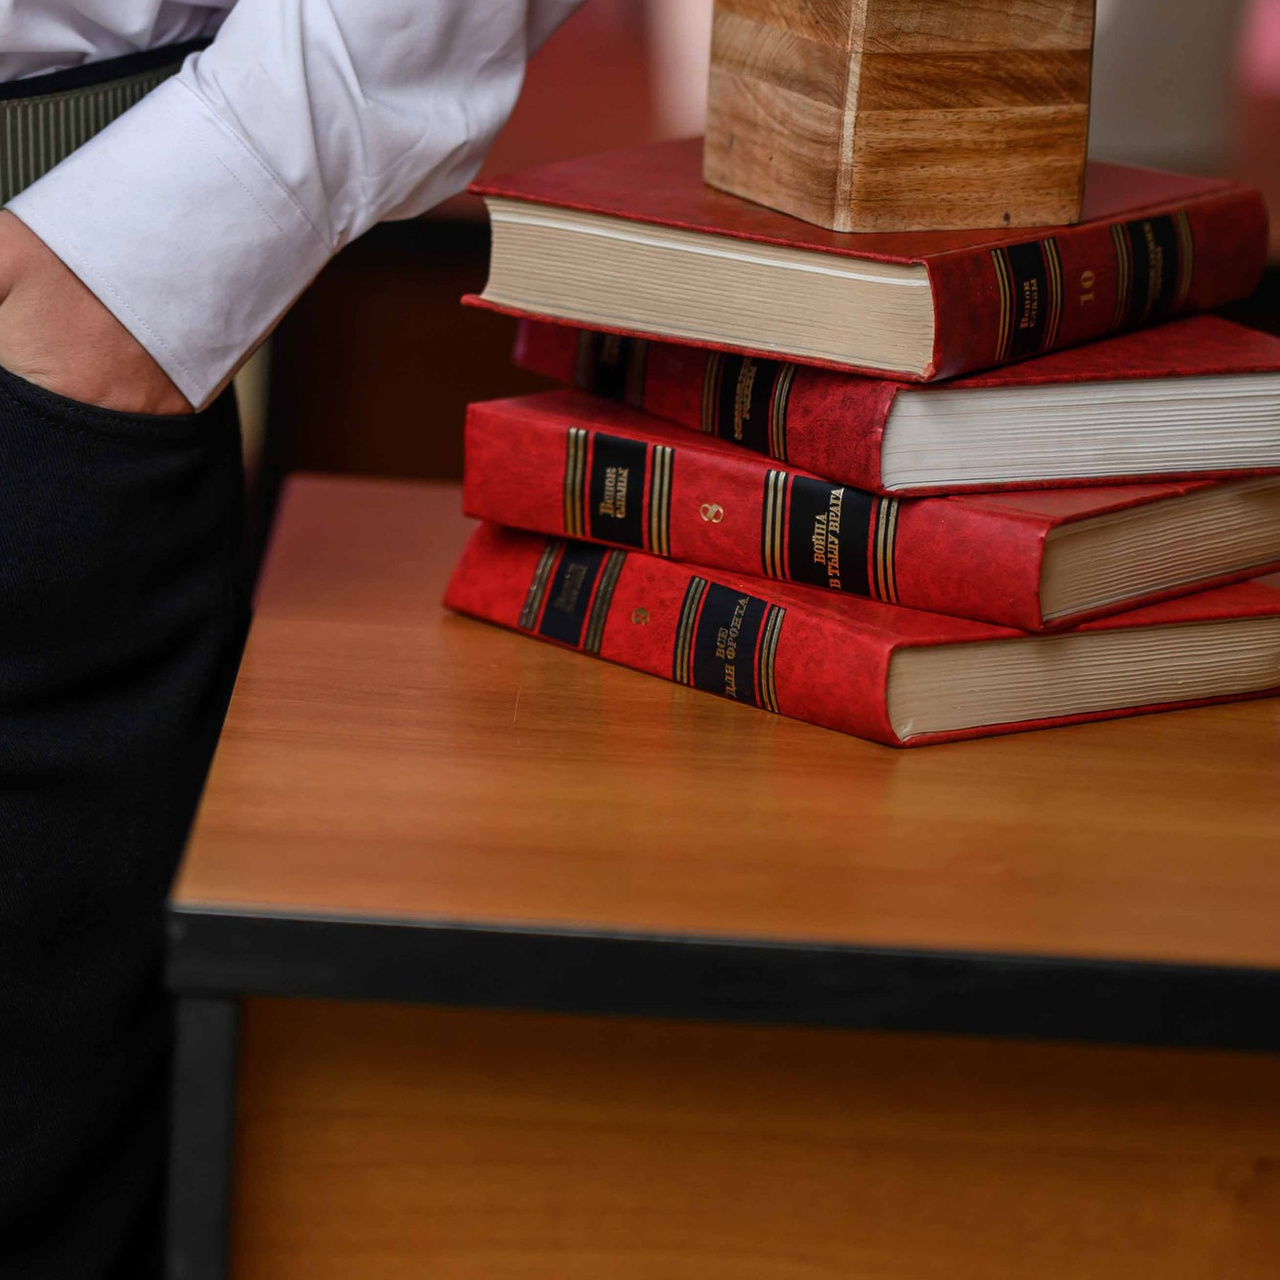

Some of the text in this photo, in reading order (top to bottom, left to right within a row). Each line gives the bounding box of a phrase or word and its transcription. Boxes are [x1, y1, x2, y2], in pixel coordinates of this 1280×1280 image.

[1080, 270, 1095, 307] 10
[699, 503, 724, 523] 8
[811, 512, 828, 565] ВОЙНА
[827, 487, 844, 589] В ТЫЛУ ВРАГА
[724, 596, 750, 698] ДЛЯ ФРОНТА
